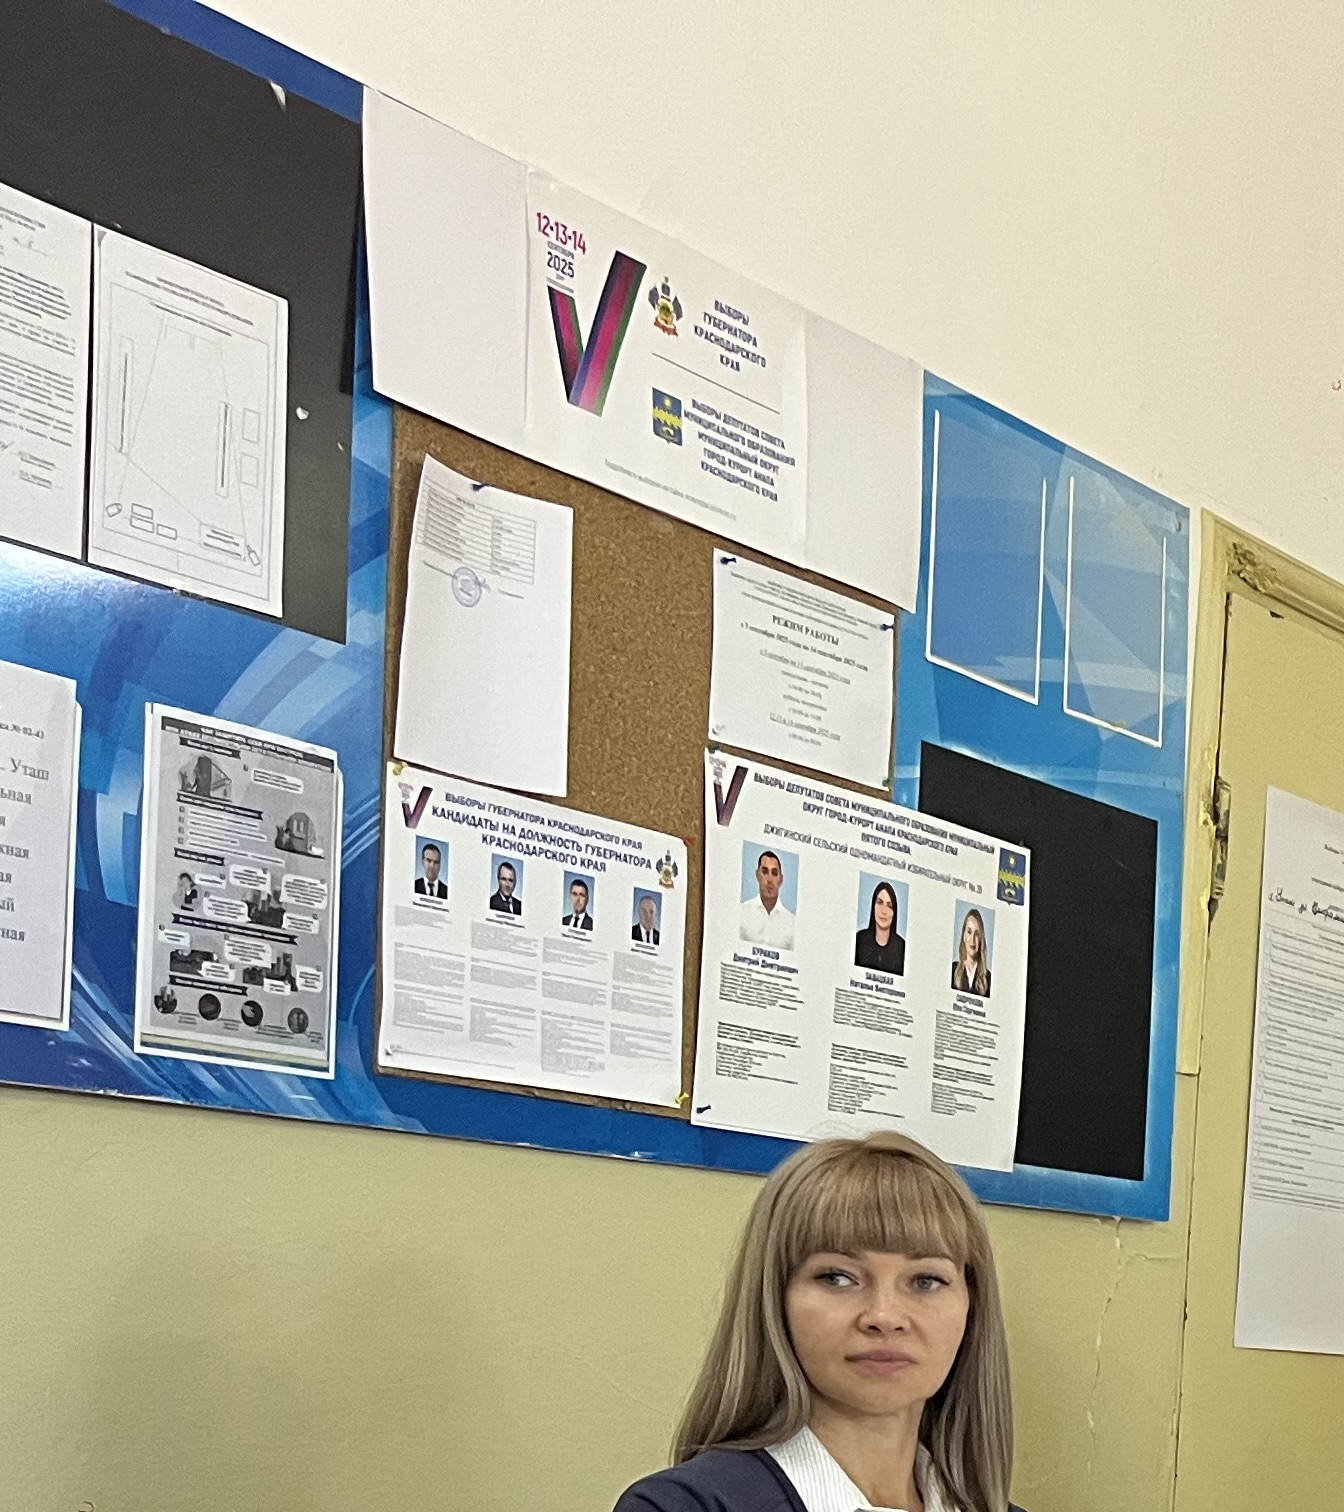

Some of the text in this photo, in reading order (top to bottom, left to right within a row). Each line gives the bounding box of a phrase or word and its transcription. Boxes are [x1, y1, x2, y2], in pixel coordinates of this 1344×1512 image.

[547, 250, 575, 278] 2025
[714, 299, 750, 326] ВЫБОРЫ
[805, 626, 839, 646] РАБОТЫ
[10, 757, 50, 781] Уташ
[445, 792, 643, 851] ВЫБОРЫ ГУБЕРНАТОРА КРАСНОДАРСКОГО КРАЯ
[431, 805, 652, 870] КАНДИДАТЫ НА ДОЛЖНОСТЬ ГУБЕРНАТОРА
[481, 833, 607, 873] КРАСНОДАРСКОГО КРАЯ
